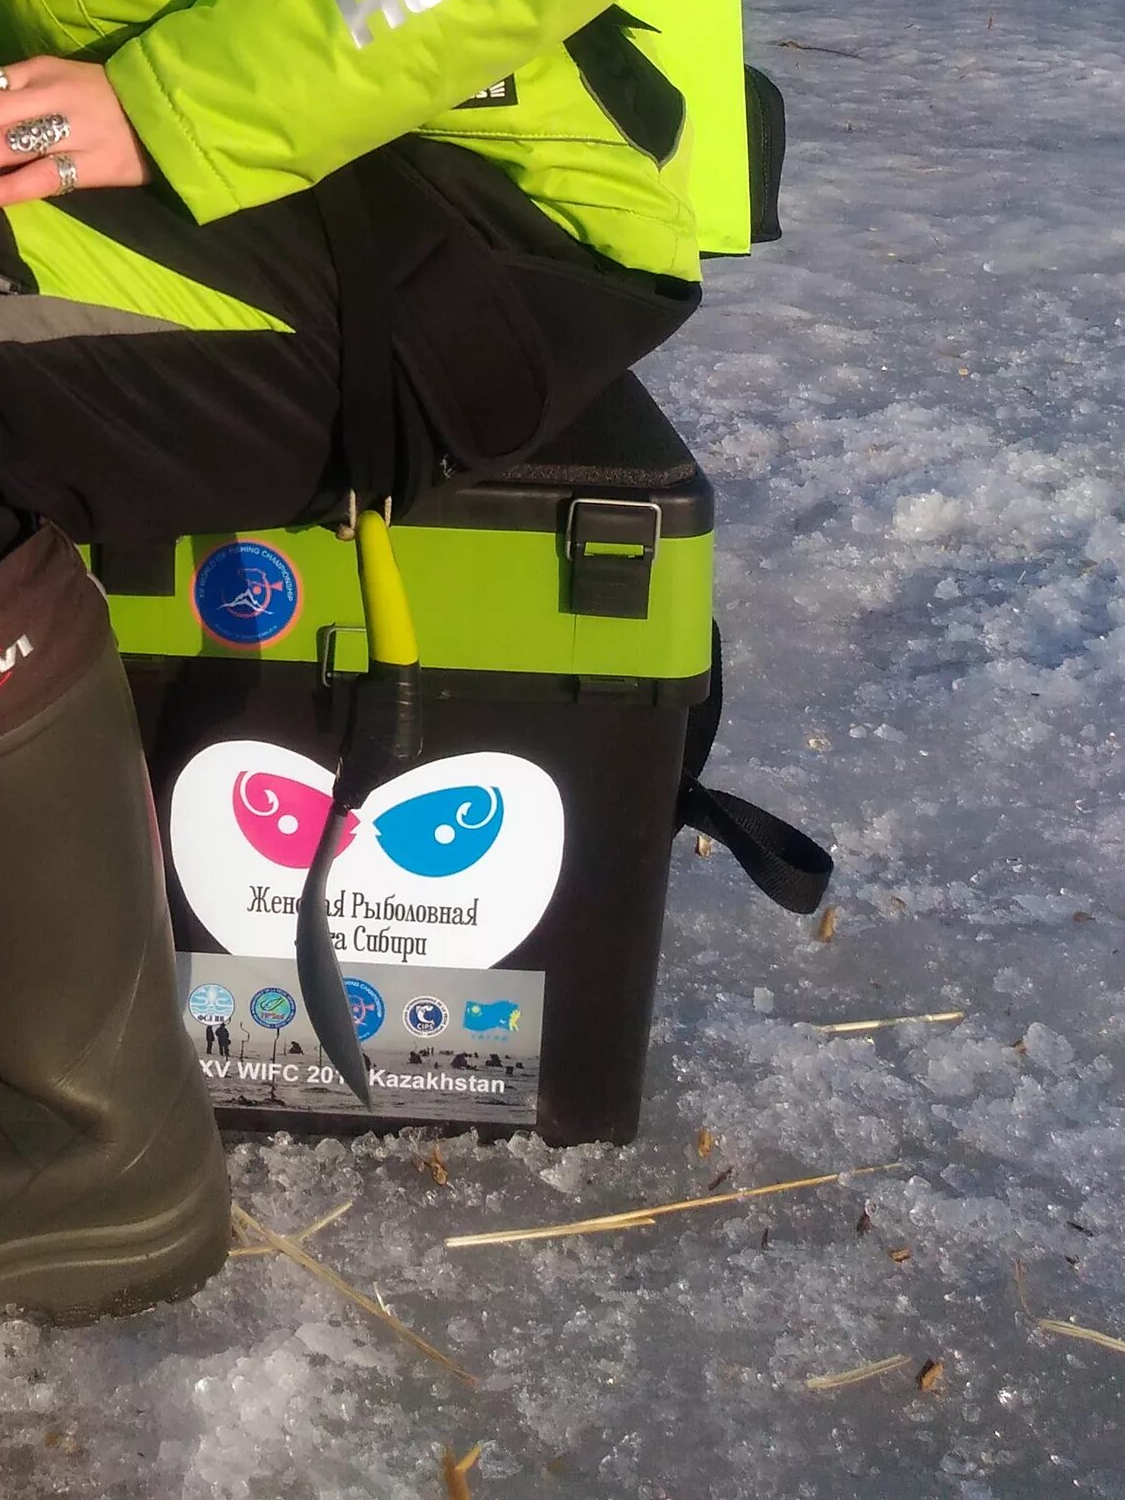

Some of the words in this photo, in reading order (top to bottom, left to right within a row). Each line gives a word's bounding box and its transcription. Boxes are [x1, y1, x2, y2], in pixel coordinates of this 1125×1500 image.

[261, 549, 296, 602] CHAMPIONSHIP
[351, 892, 479, 927] Рыболовная
[353, 925, 428, 963] Сибири
[416, 1022, 435, 1031] CIPS
[237, 1062, 299, 1083] WIFC
[306, 1065, 345, 1085] 201
[369, 1068, 506, 1094] Kazakhstan
